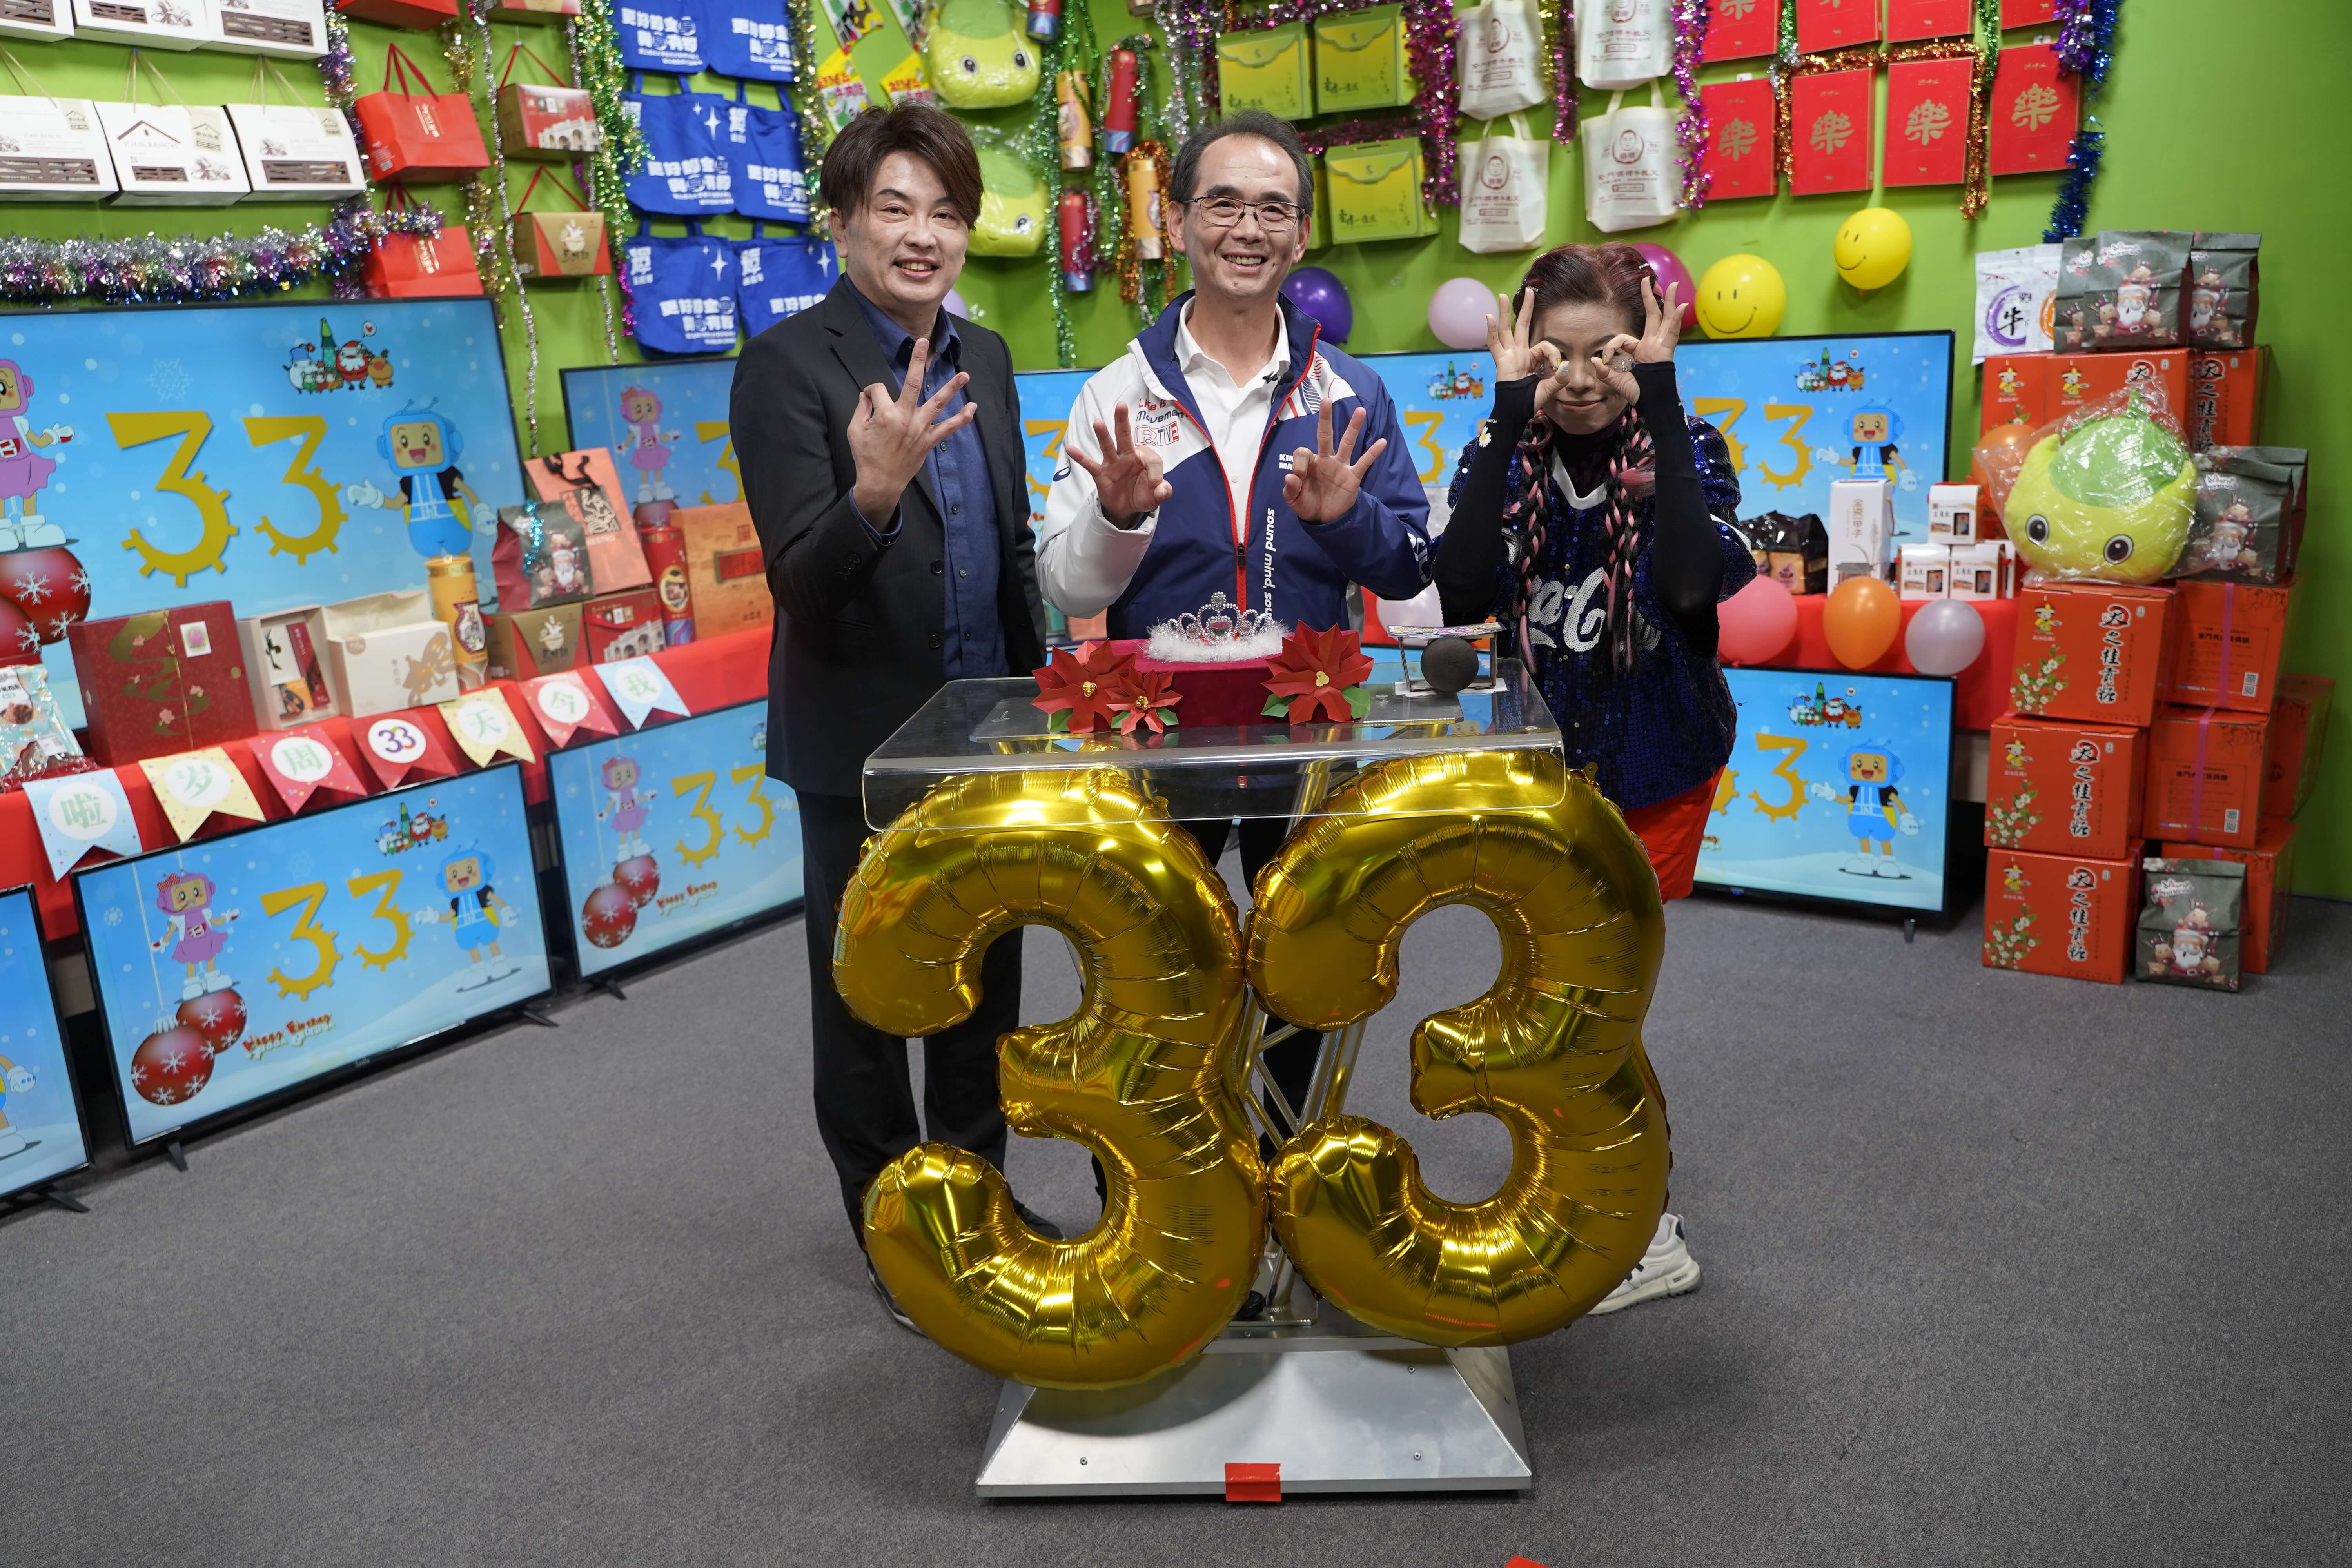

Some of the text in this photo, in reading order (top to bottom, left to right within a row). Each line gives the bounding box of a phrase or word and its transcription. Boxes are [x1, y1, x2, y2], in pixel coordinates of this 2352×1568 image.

[1904, 99, 1952, 145] 樂
[2011, 83, 2061, 131] 樂
[1718, 117, 1759, 160] 樂
[1810, 109, 1854, 155] 樂
[1998, 307, 2023, 336] 牛
[105, 411, 348, 587] 33
[1266, 508, 1276, 552] sound
[1263, 553, 1276, 588] mind,
[282, 744, 323, 776] 周
[378, 726, 417, 753] 33
[471, 709, 502, 739] 天
[550, 690, 575, 715] 今
[625, 670, 658, 697] 我
[671, 763, 776, 869] 33
[260, 869, 416, 1001] 33
